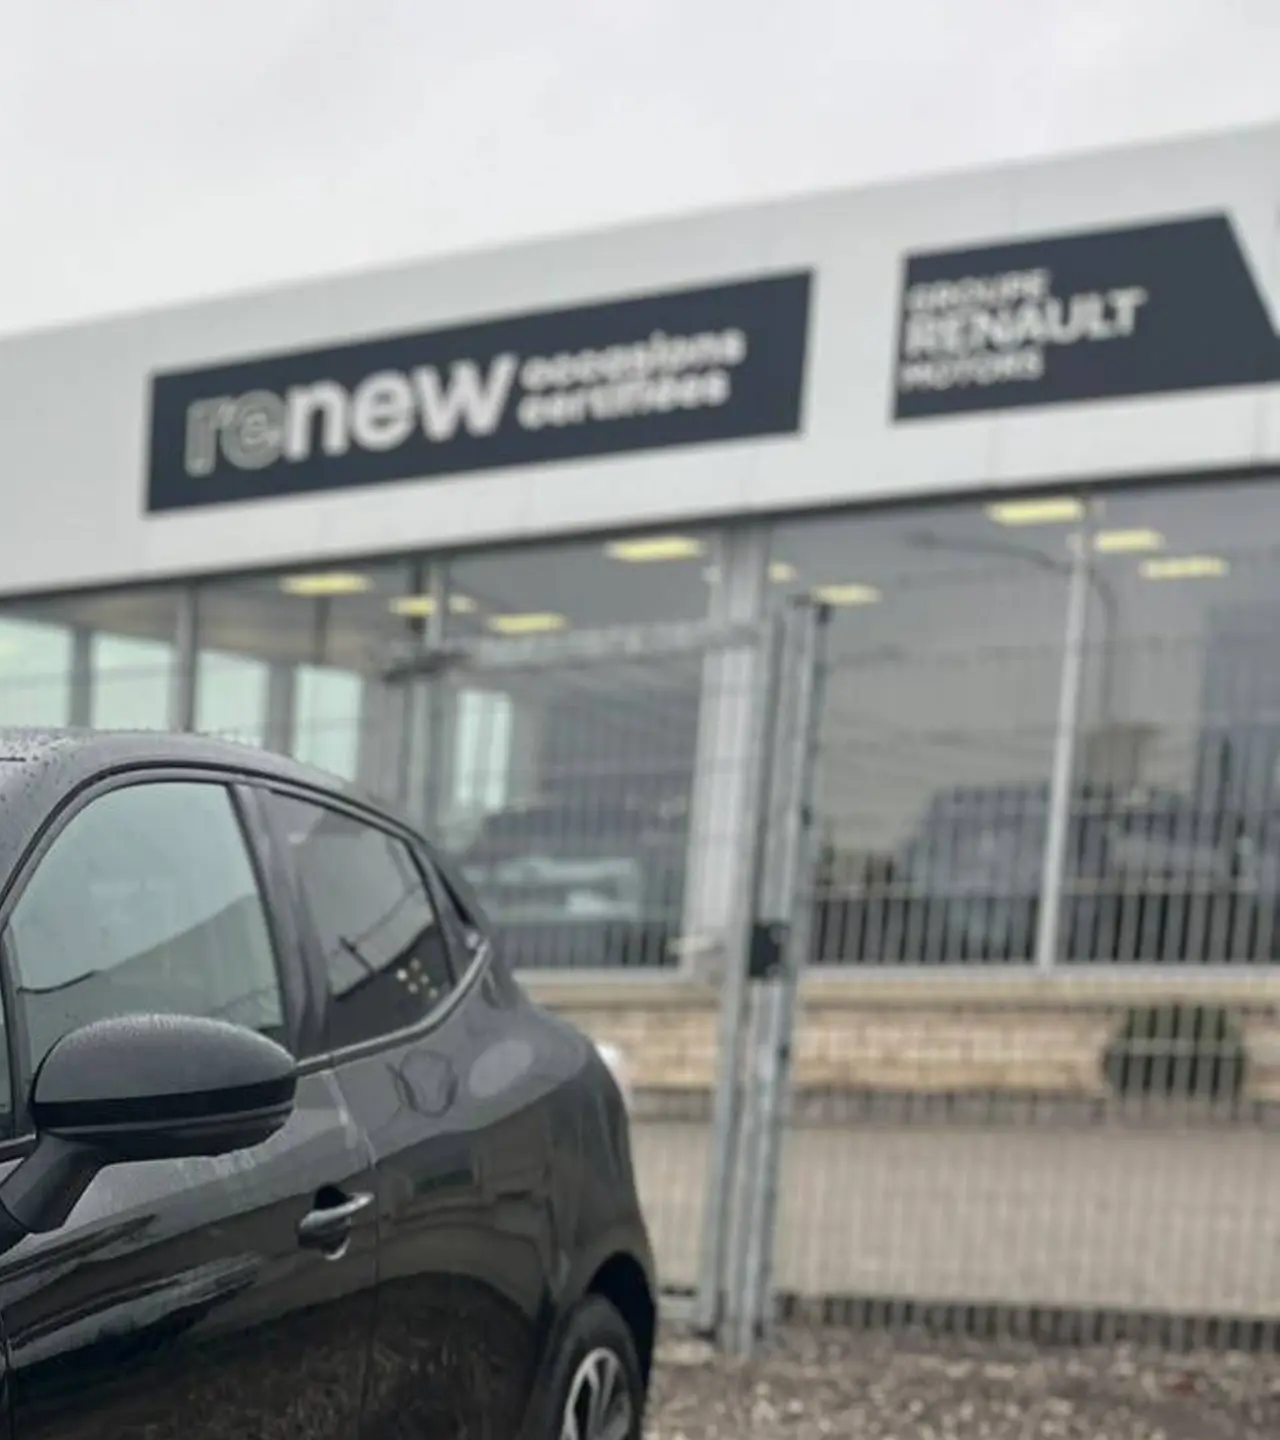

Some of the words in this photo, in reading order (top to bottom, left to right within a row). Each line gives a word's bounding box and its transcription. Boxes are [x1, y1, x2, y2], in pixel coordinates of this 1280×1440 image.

[905, 286, 1148, 358] RENAULT
[521, 328, 747, 391] occasions
[184, 353, 520, 477] renew
